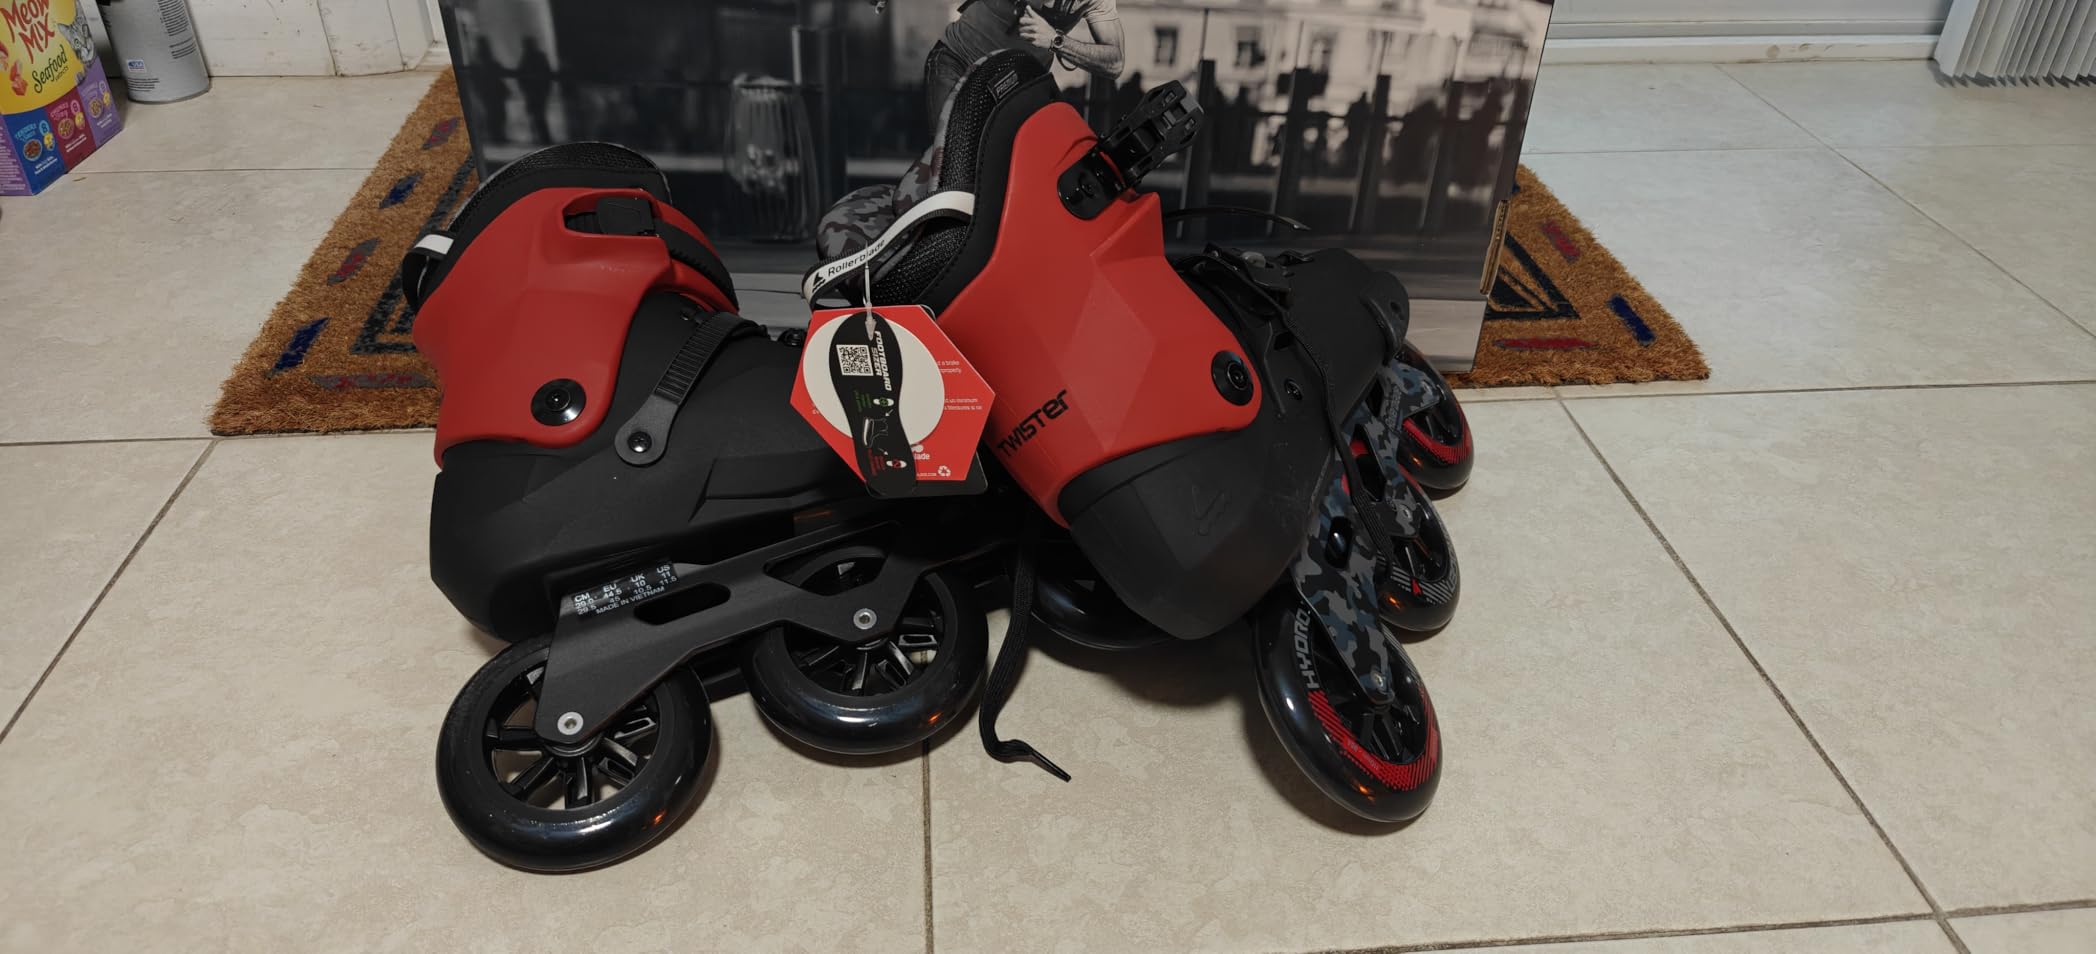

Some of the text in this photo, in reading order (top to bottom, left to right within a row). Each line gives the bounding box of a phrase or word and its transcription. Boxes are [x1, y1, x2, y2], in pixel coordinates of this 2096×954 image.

[32, 44, 67, 93] Seafood
[828, 239, 885, 277] Rollerblade
[871, 346, 882, 376] SIZER
[874, 330, 892, 391] FOOTBOARD
[575, 564, 671, 602] CM EU UK US
[635, 579, 646, 588] 10
[661, 570, 671, 578] 11
[595, 585, 665, 614] MADE IN VIETNAM
[1294, 602, 1320, 689] HYDRO
